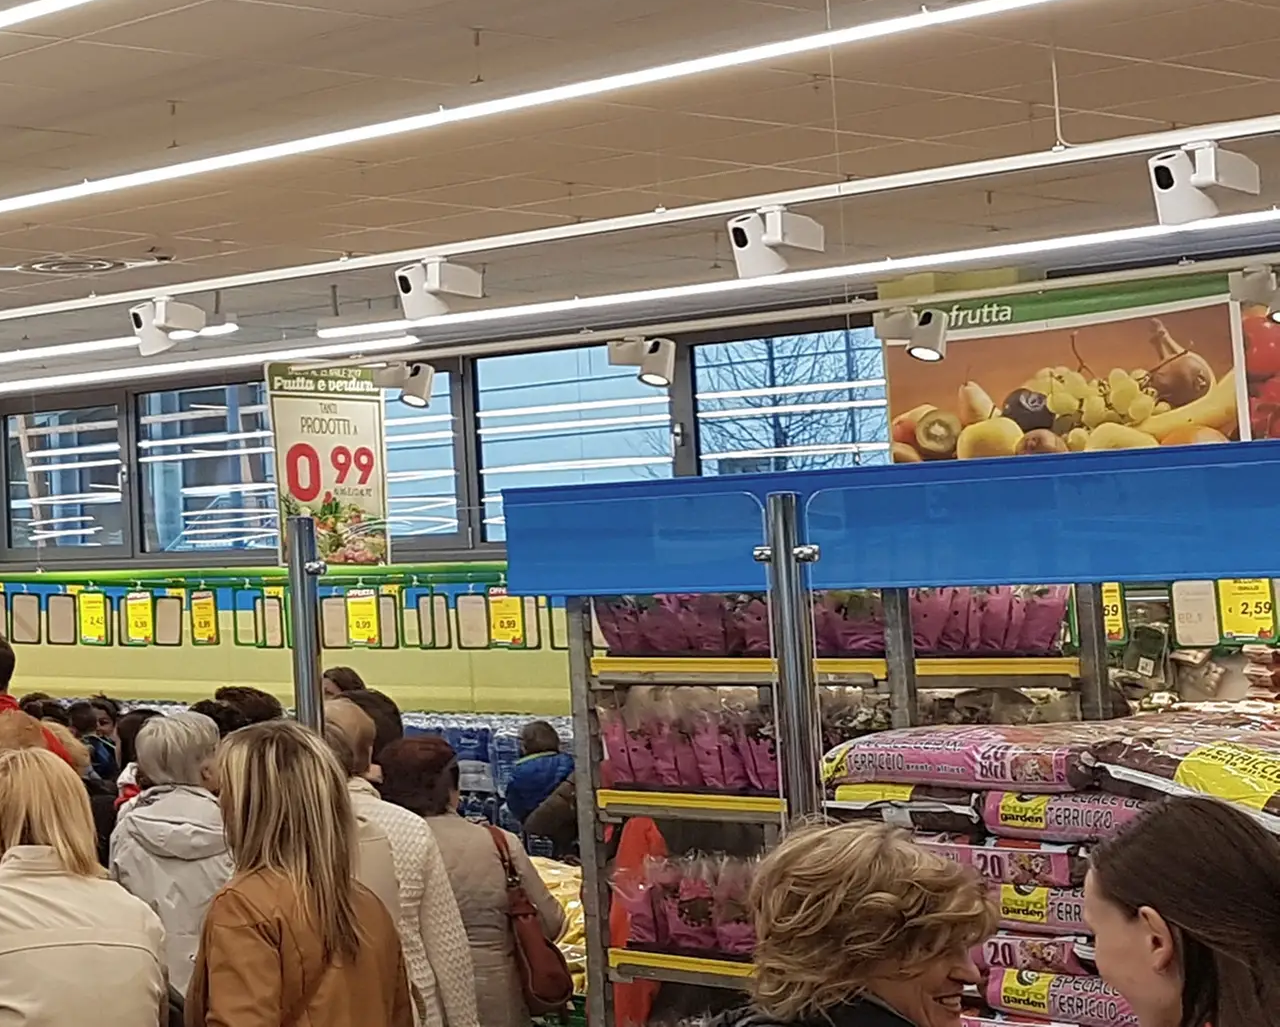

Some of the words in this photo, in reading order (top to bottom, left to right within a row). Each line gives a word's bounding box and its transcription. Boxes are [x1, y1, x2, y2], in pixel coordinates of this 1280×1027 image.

[949, 303, 1012, 327] frutta
[317, 379, 326, 391] e
[319, 402, 337, 415] TANTI
[300, 416, 351, 435] PRODOTTI
[286, 443, 374, 503] 0,99
[1240, 602, 1272, 617] 2,59
[848, 752, 904, 771] TERRICCIO
[1001, 813, 1043, 824] garden
[1047, 807, 1113, 829] TERRICCIO
[977, 853, 1002, 878] 20
[1002, 906, 1044, 919] garden
[1003, 899, 1045, 910] euro
[988, 942, 1013, 966] 20
[1004, 985, 1045, 1000] euro
[1003, 996, 1045, 1009] garden
[1050, 994, 1117, 1019] TERRICCIO
